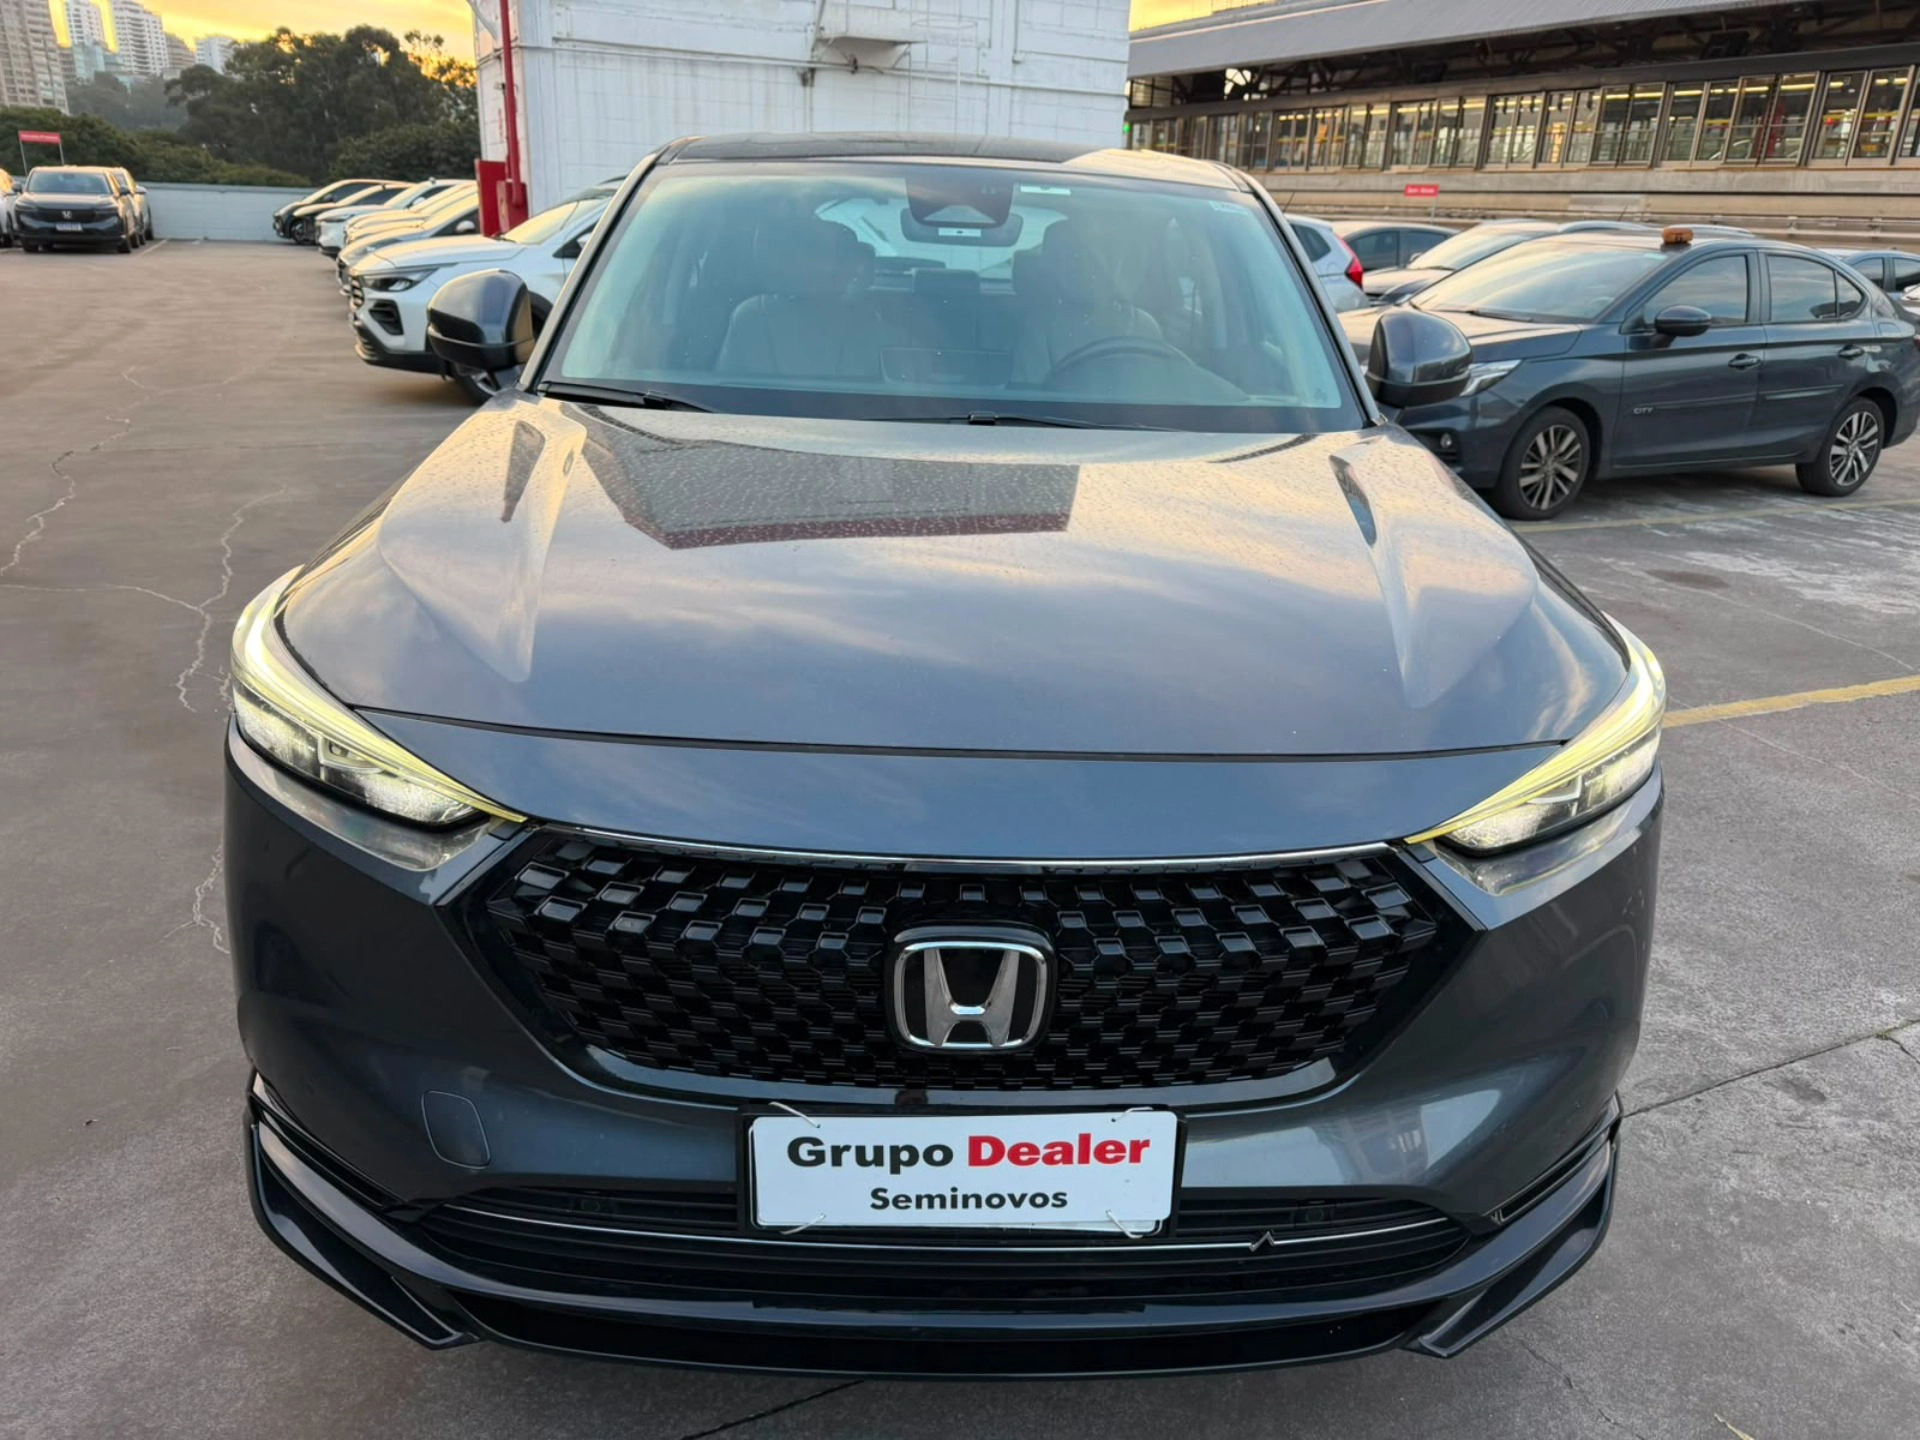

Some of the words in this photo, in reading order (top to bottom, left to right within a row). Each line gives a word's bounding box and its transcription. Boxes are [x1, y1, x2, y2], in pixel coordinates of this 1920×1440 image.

[787, 1136, 954, 1175] Grupo
[968, 1133, 1151, 1167] Dealer
[870, 1186, 1068, 1210] Seminovos
